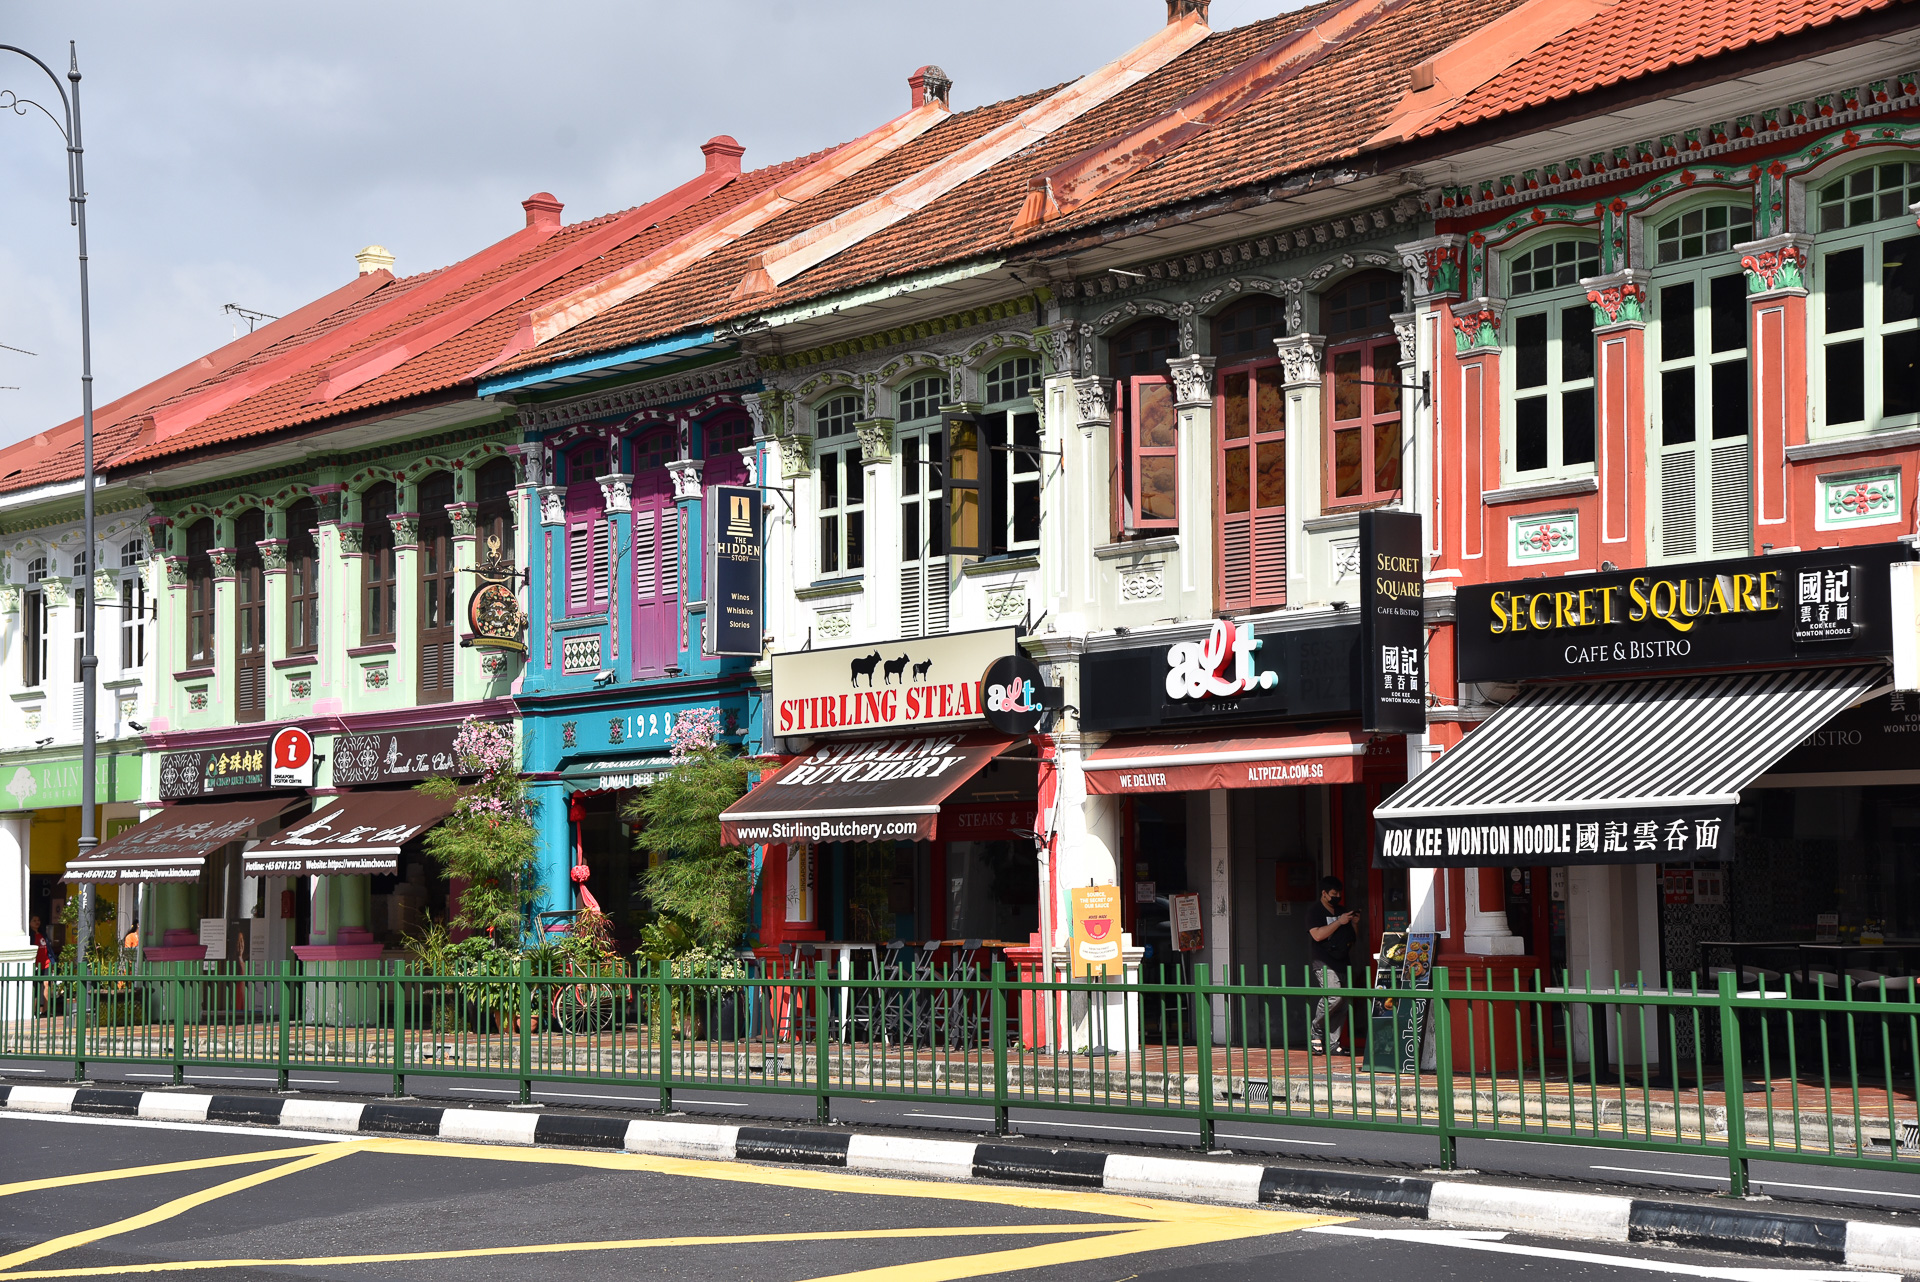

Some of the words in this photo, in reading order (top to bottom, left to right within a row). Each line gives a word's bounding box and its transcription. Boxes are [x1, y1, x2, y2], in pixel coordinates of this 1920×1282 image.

[717, 542, 760, 557] HIDDEN
[731, 554, 750, 562] STORY
[1377, 553, 1420, 574] SECRET
[1376, 577, 1421, 601] SQUARE
[1798, 569, 1850, 605] 國記
[731, 593, 750, 601] Wines
[1490, 585, 1619, 635] SECRET
[1629, 570, 1781, 633] SQUARE
[726, 607, 754, 616] Whiskies
[1377, 606, 1394, 615] CAFE
[1394, 607, 1400, 615] &
[1400, 607, 1420, 617] BISTRO
[1800, 602, 1848, 623] 雲吞面
[729, 621, 751, 629] Stories
[1810, 622, 1823, 630] KOK
[1825, 628, 1851, 636] NOODLE
[1382, 645, 1419, 676] 國記
[1564, 645, 1609, 665] CAFE
[1613, 641, 1627, 661] &
[1630, 639, 1692, 661] BISTRO
[1384, 674, 1418, 691] 雲吞面
[780, 688, 898, 732] STIRLING
[1211, 703, 1239, 711] PIZZA
[626, 711, 672, 739] 1928
[803, 733, 967, 766] STIRLING
[583, 762, 594, 771] A
[594, 757, 649, 770] PERANAKAN
[776, 756, 967, 786] BUTCHERY
[1248, 763, 1324, 781] ALTPIZZA.COM.SG
[599, 773, 630, 788] RUMAH
[632, 770, 655, 785] BEBE
[1119, 775, 1133, 788] WE
[1133, 772, 1167, 788] DELIVER
[958, 812, 1004, 827] STEAKS
[737, 820, 918, 841] www.StirlingButchery.com
[1382, 828, 1412, 857] KOK
[1414, 827, 1442, 856] KEE
[1447, 825, 1510, 856] WONTON
[1513, 823, 1571, 855] NOODLE
[1575, 817, 1723, 854] 國記雲吞面
[245, 861, 265, 871] Hotline:
[264, 861, 275, 870] +65
[274, 860, 287, 870] 6741
[288, 860, 302, 870] 2125
[305, 859, 328, 870] Website:
